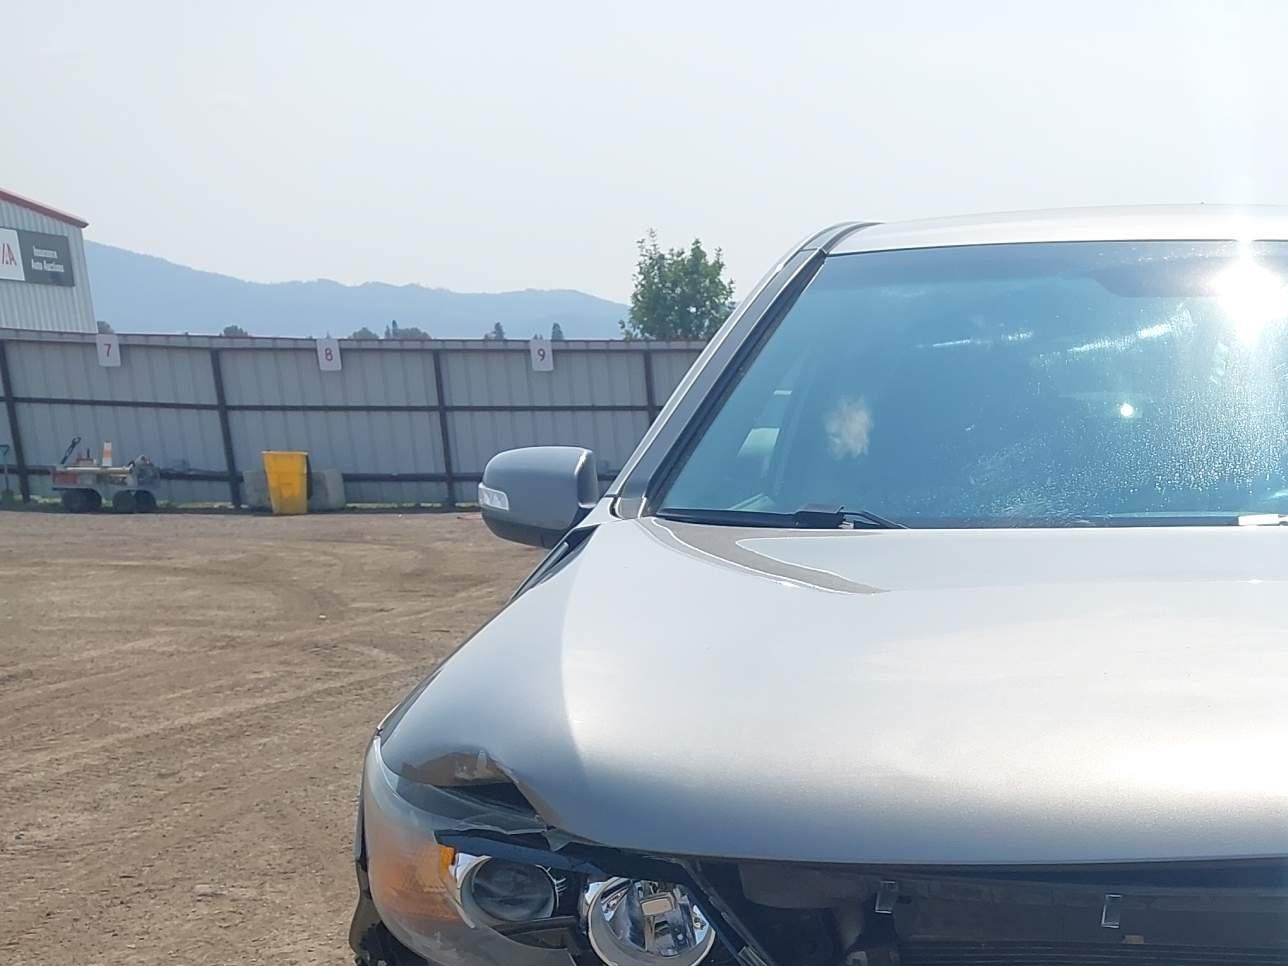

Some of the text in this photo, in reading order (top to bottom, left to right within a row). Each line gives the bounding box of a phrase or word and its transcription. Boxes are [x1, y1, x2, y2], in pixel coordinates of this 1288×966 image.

[103, 343, 112, 357] 7
[324, 347, 333, 361] 8
[537, 348, 546, 361] 9
